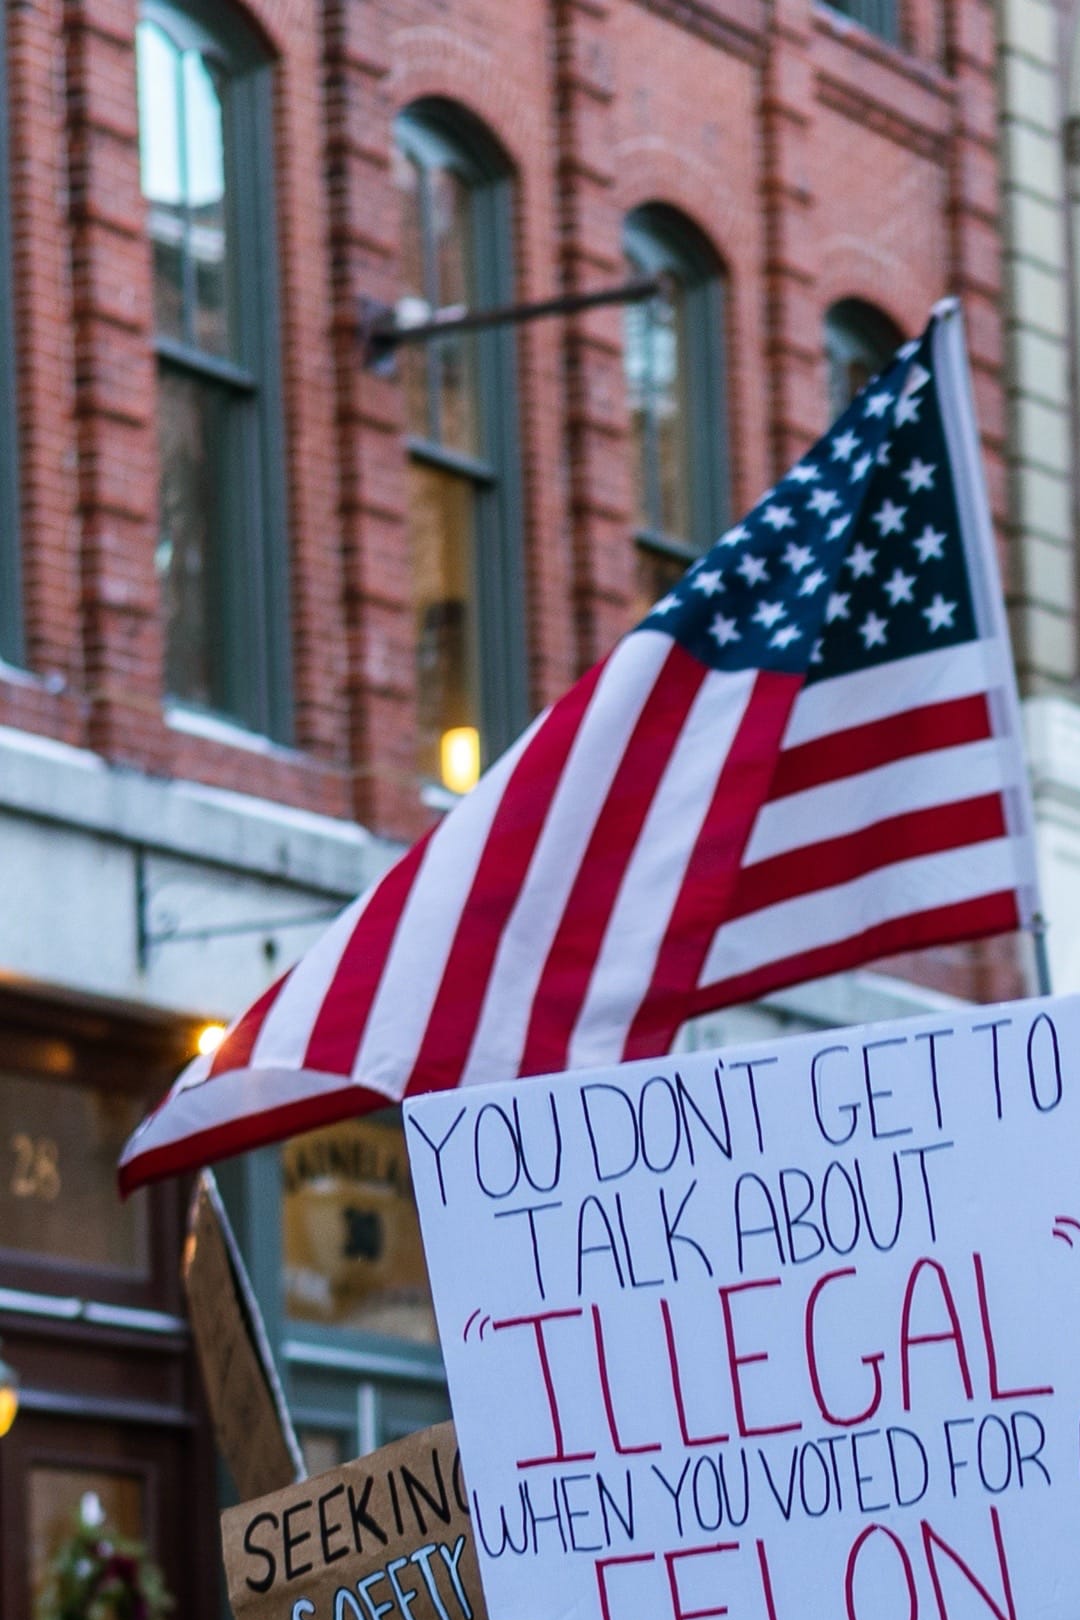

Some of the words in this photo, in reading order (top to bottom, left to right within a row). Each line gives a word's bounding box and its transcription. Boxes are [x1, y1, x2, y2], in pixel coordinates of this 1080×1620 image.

[408, 1091, 561, 1206] YOU
[579, 1056, 779, 1182] DON'T
[810, 1028, 955, 1146] GET
[972, 1012, 1064, 1119] TO
[494, 1179, 714, 1300] TALK
[735, 1141, 955, 1274] ABOUT
[473, 1472, 635, 1559] WHEN
[652, 1447, 751, 1537] YOU
[757, 1426, 929, 1524] VOTED
[944, 1411, 1052, 1500] FOR
